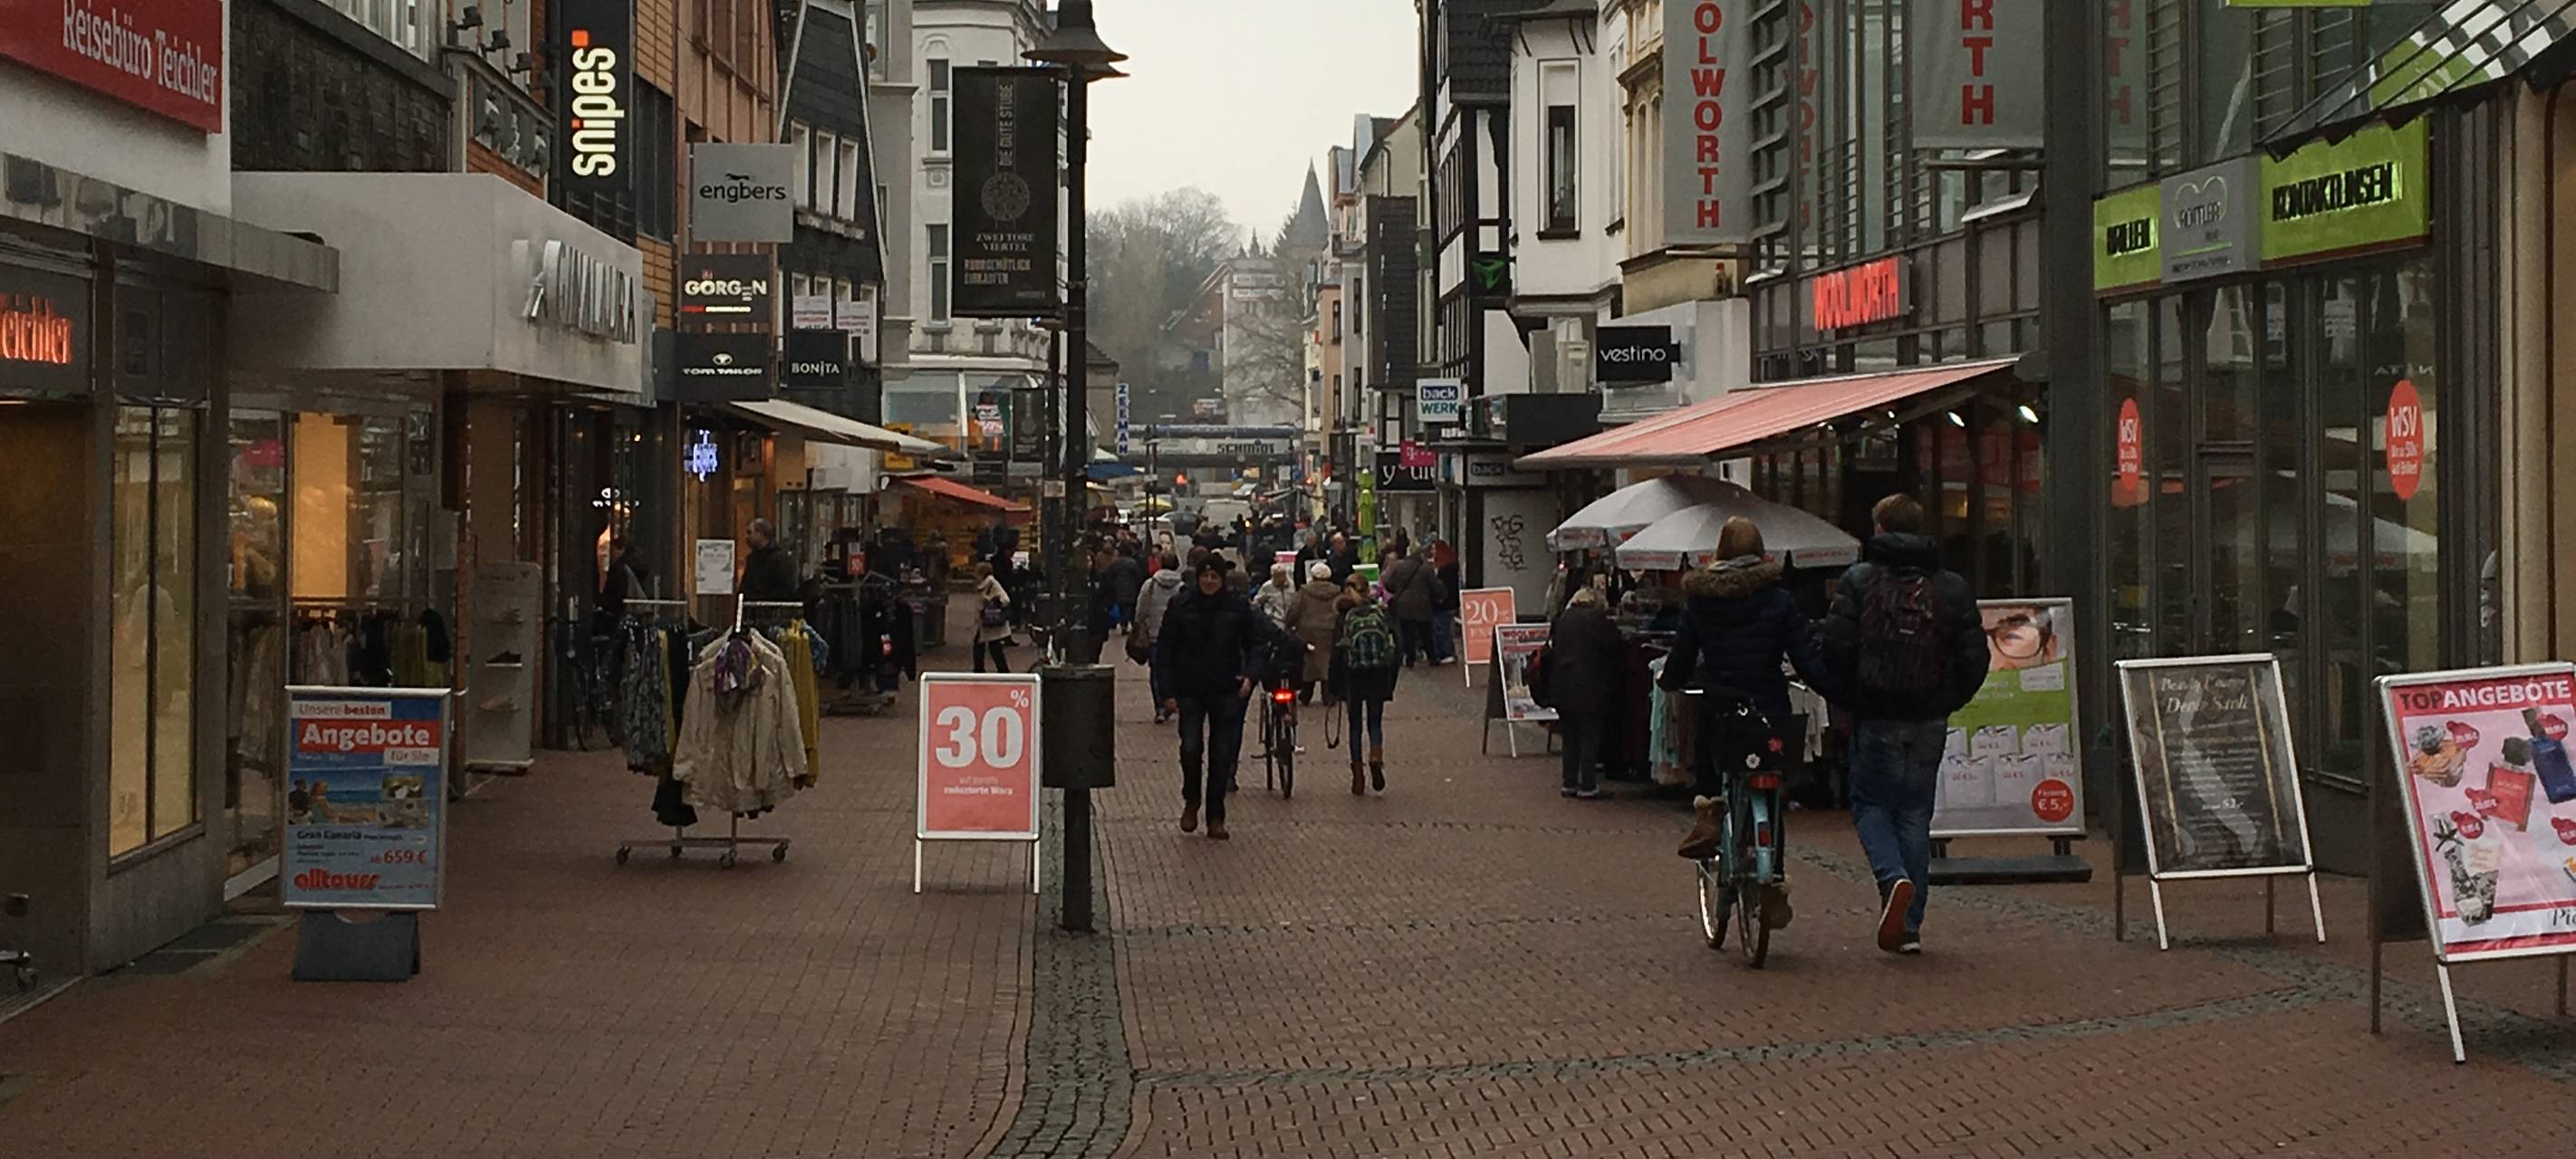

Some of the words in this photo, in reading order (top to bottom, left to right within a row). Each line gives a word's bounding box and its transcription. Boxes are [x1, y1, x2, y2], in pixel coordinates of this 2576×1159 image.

[62, 0, 151, 80] Reisebüro
[155, 28, 217, 105] Teichler
[572, 46, 625, 177] snipes
[699, 182, 787, 205] engbers
[2272, 161, 2396, 222] KONTAKTLINSEN
[1813, 257, 1899, 331] WOOLWORTH
[1600, 344, 1667, 363] vestino
[682, 368, 716, 376] TOM
[718, 368, 763, 376] TAILOR
[791, 360, 841, 377] BONITA
[1422, 387, 1457, 400] back
[1420, 402, 1458, 415] WERK
[2391, 405, 2417, 437] WSV
[1466, 599, 1498, 624] 20
[299, 703, 341, 715] Unsere
[344, 704, 385, 715] besten
[303, 723, 430, 752] Angebote
[936, 705, 1024, 769] 30
[1010, 690, 1029, 708] %
[383, 849, 414, 865] 659
[418, 849, 428, 865] €
